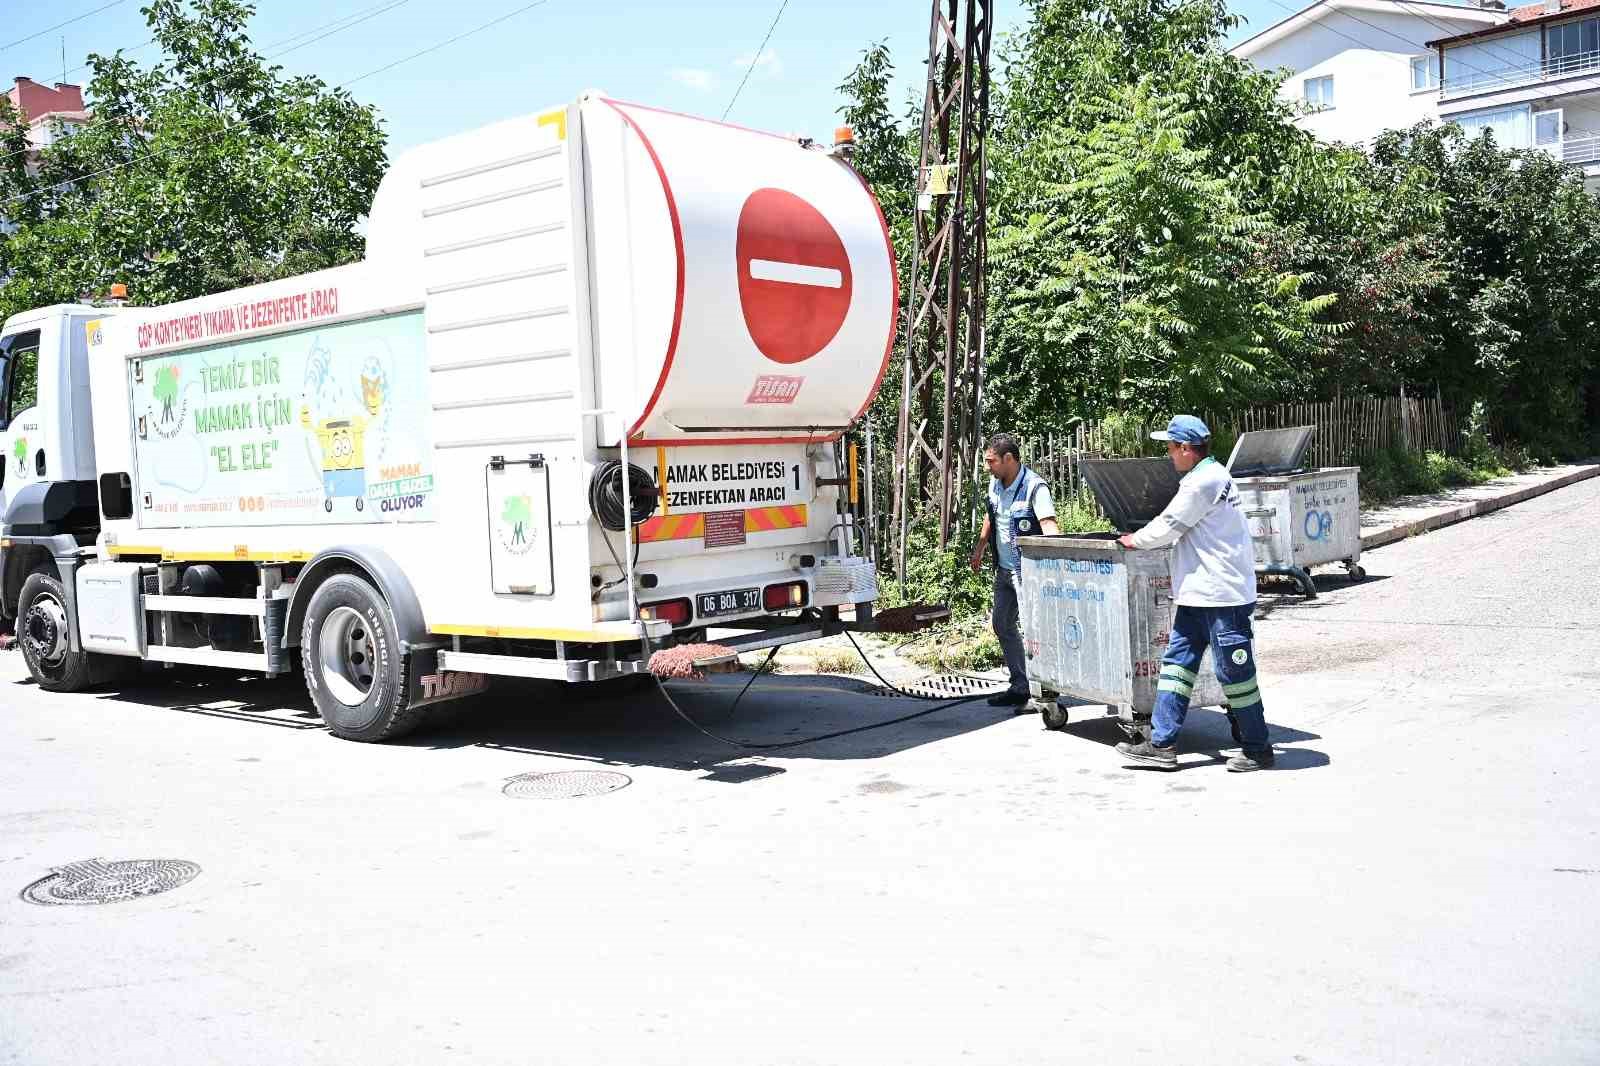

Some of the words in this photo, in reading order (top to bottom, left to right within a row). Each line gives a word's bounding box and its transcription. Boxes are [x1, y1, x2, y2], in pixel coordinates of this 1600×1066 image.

[203, 308, 235, 337] YIKAMA
[237, 303, 249, 330] VE
[251, 293, 307, 328] DEZENFEKTE
[310, 287, 339, 318] ARACI
[200, 358, 248, 394] TEMİZ
[252, 352, 281, 387] BİR
[195, 402, 252, 434] MAMAK
[712, 461, 785, 481] BELEDİYESİ
[791, 465, 800, 490] 1
[750, 487, 785, 501] ARACI
[704, 596, 716, 611] 06
[720, 593, 737, 610] BOA
[743, 591, 758, 607] 317
